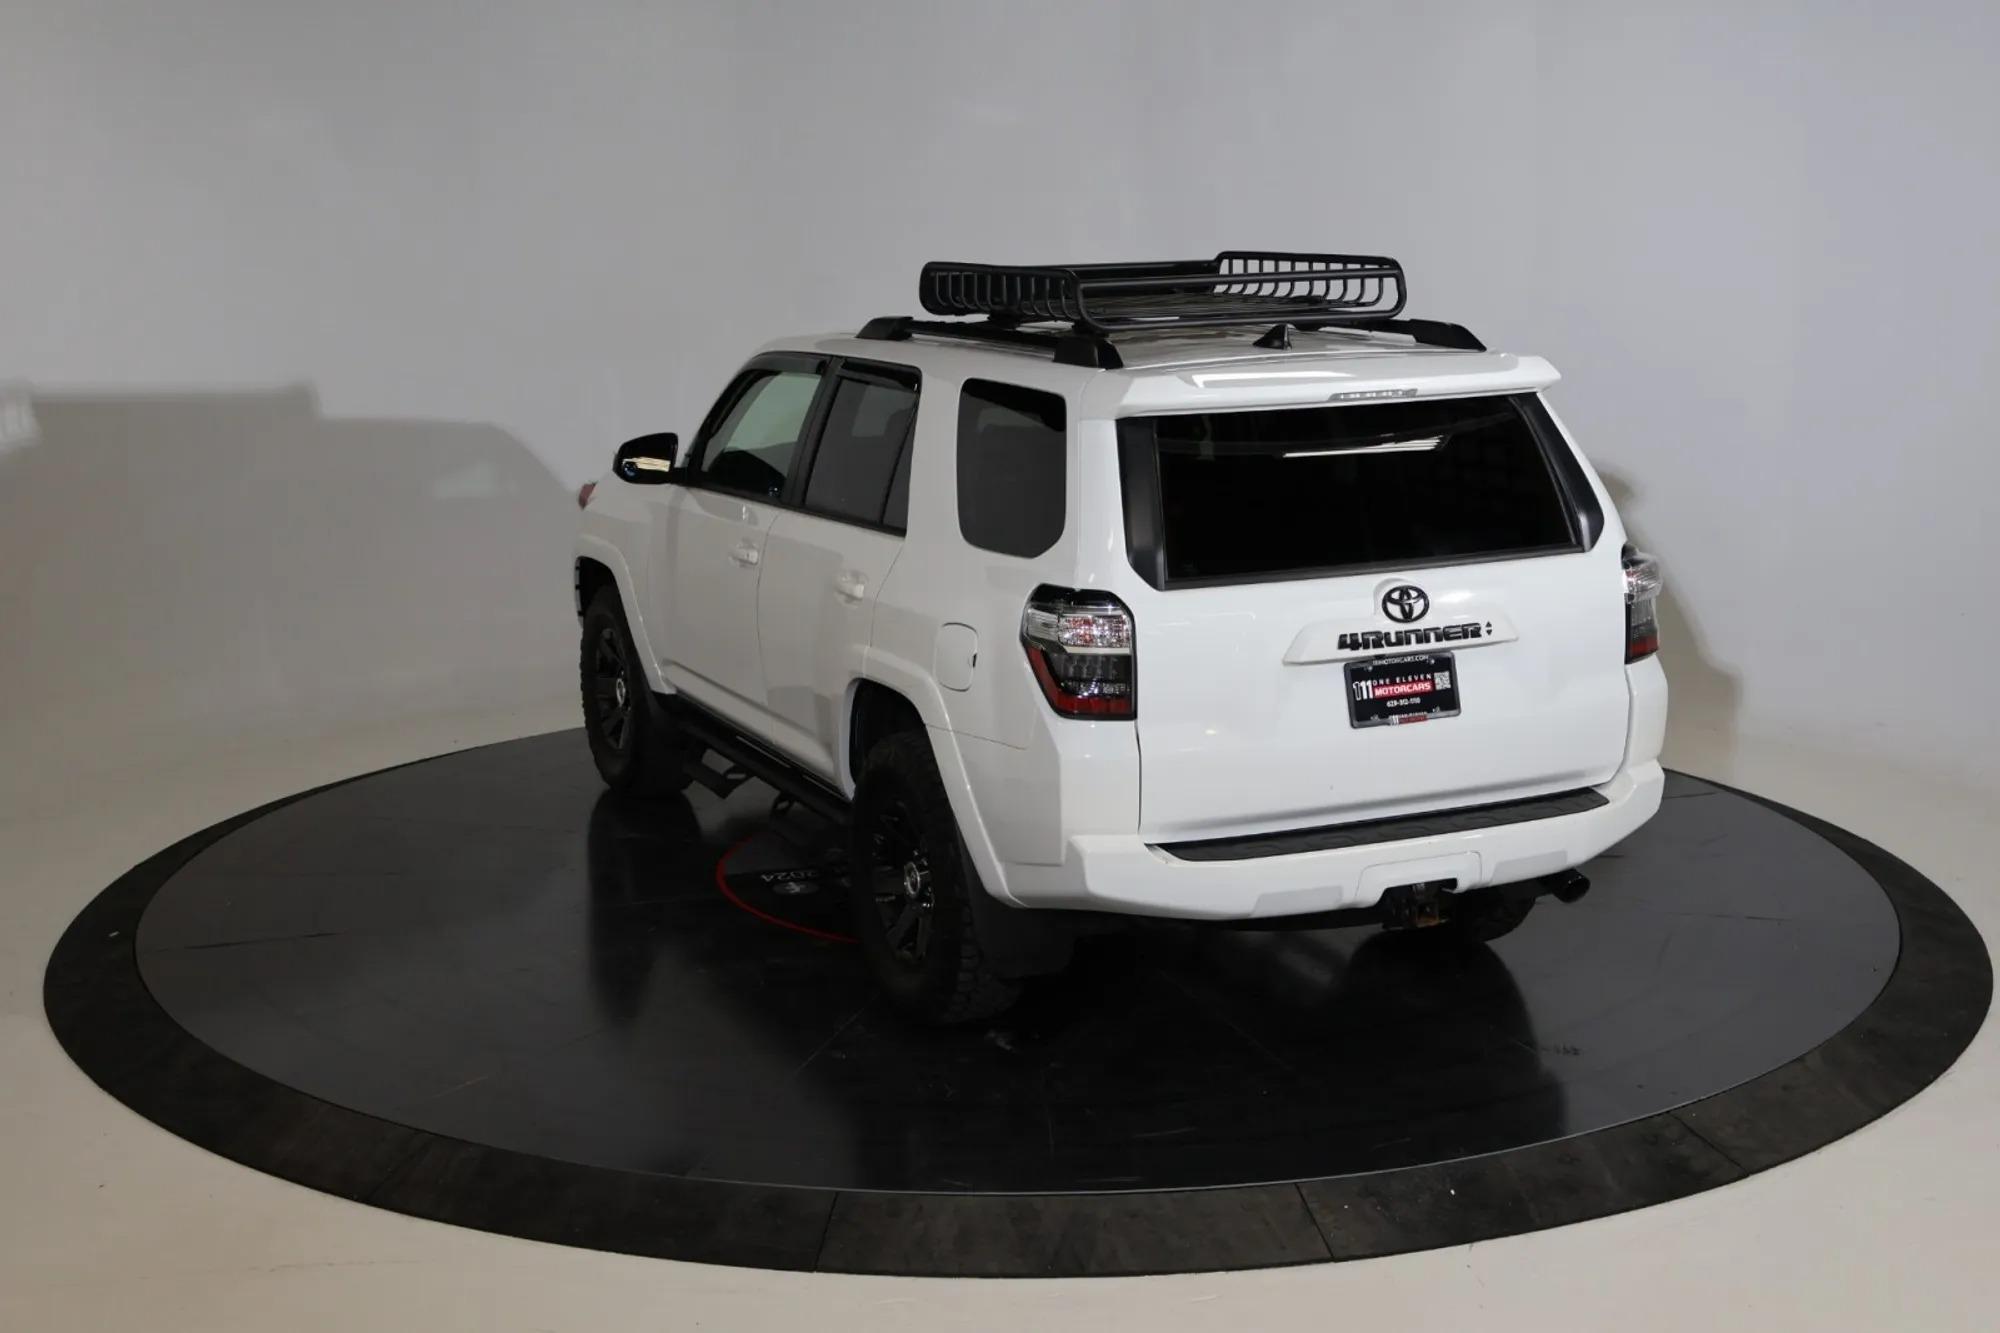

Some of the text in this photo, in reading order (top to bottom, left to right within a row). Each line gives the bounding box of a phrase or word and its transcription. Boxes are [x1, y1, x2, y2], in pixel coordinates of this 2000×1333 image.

[1337, 622, 1482, 651] 4RUNNER
[1373, 673, 1432, 686] ONE ELEVEN
[1352, 680, 1373, 701] 111
[1374, 682, 1432, 697] MOTORCARS
